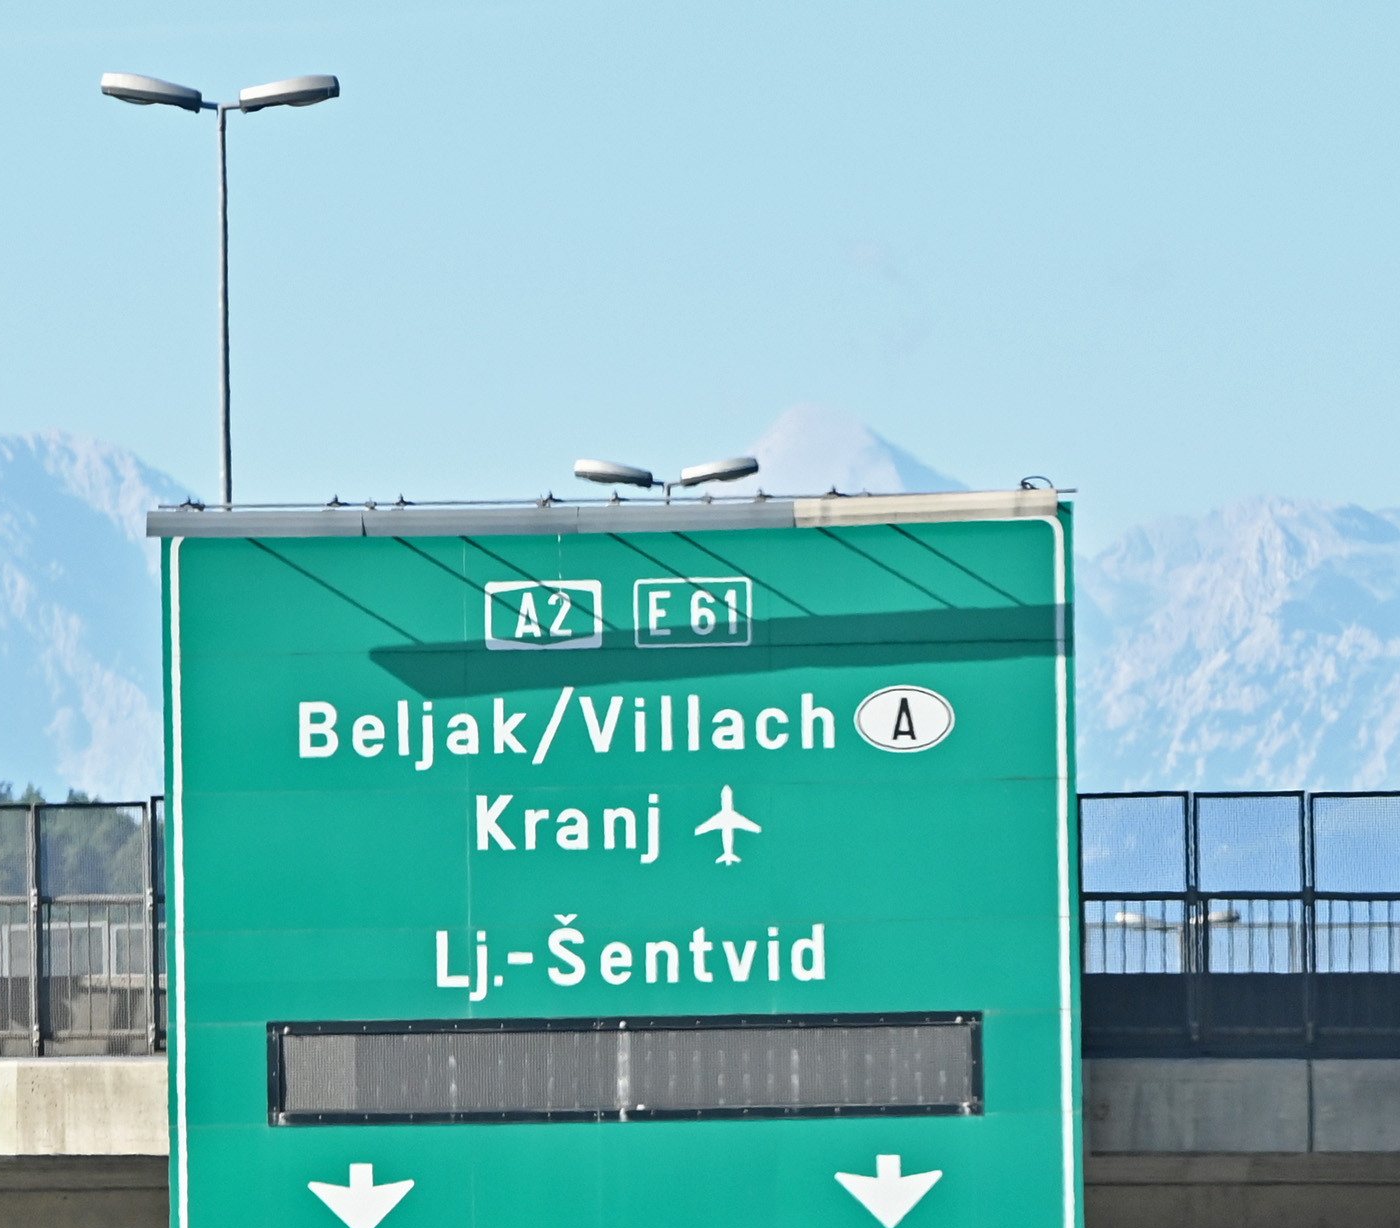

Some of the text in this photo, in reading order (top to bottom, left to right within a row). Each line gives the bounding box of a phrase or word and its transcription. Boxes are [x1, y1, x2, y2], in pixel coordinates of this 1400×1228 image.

[514, 591, 572, 638] A2
[649, 588, 738, 636] E 61
[297, 686, 837, 771] Beljak/Villach
[891, 697, 917, 743] A
[475, 794, 662, 865] Kranj
[436, 913, 827, 1001] Lj.-Šentvid
